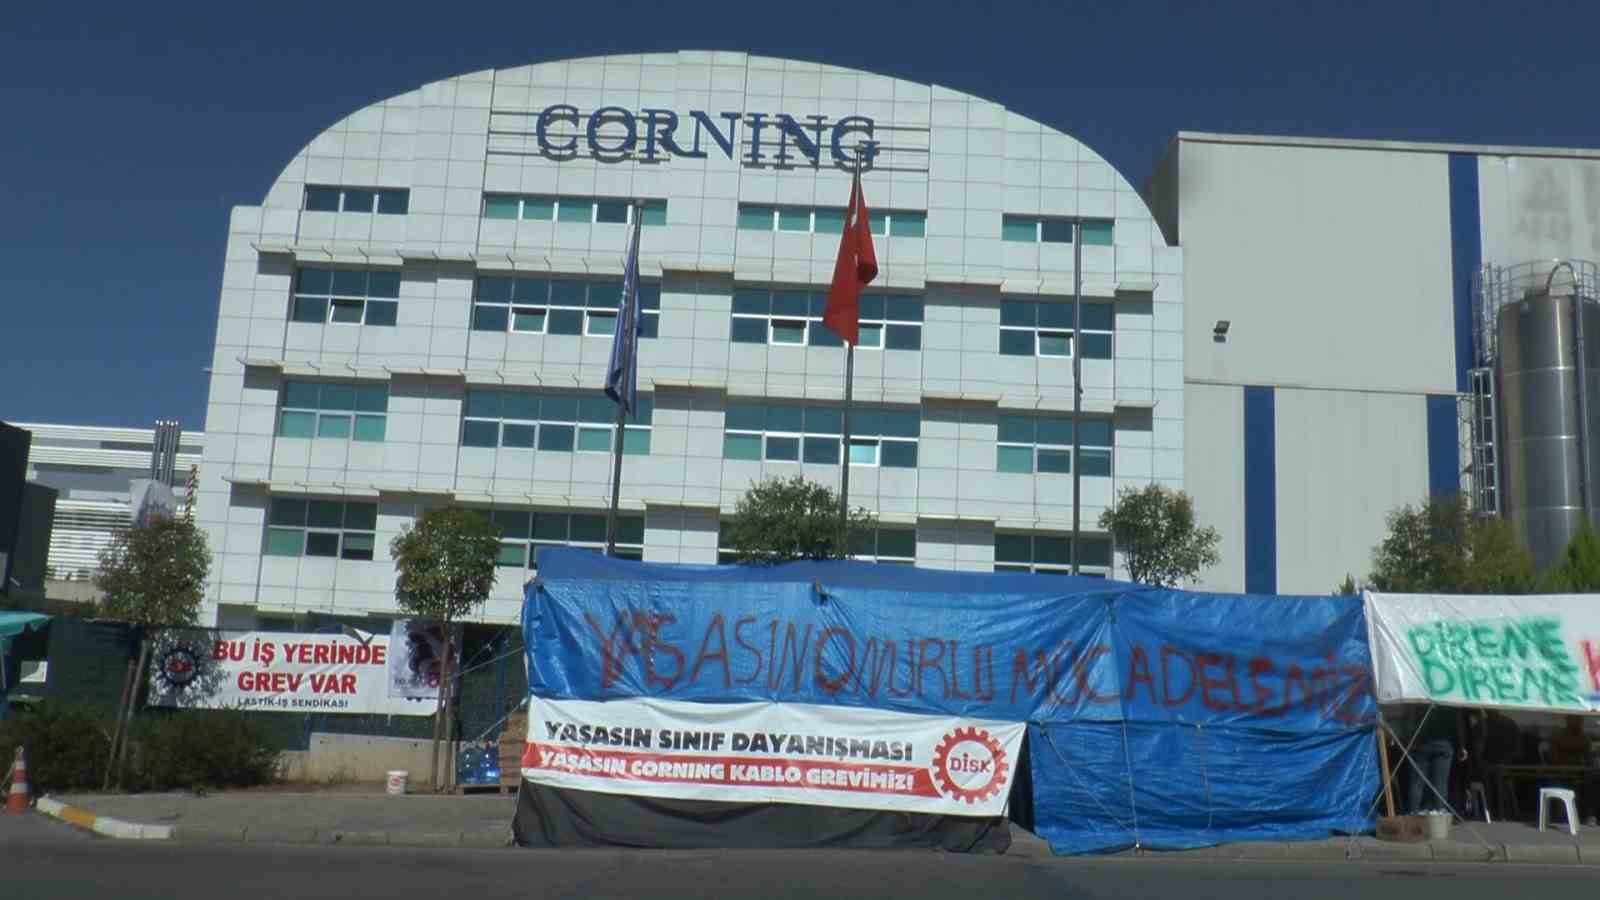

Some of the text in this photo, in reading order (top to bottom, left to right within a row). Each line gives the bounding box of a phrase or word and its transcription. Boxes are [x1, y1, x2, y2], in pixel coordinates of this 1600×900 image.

[536, 104, 879, 168] CORNING
[213, 637, 386, 667] BU İŞ YERİNDE
[238, 671, 357, 694] GREV VAR
[659, 729, 725, 751] SINIF
[732, 733, 913, 761] DAYANIŞMASI
[541, 750, 914, 790] YAŞASIN CORNING KABLO GREVİMİZ!
